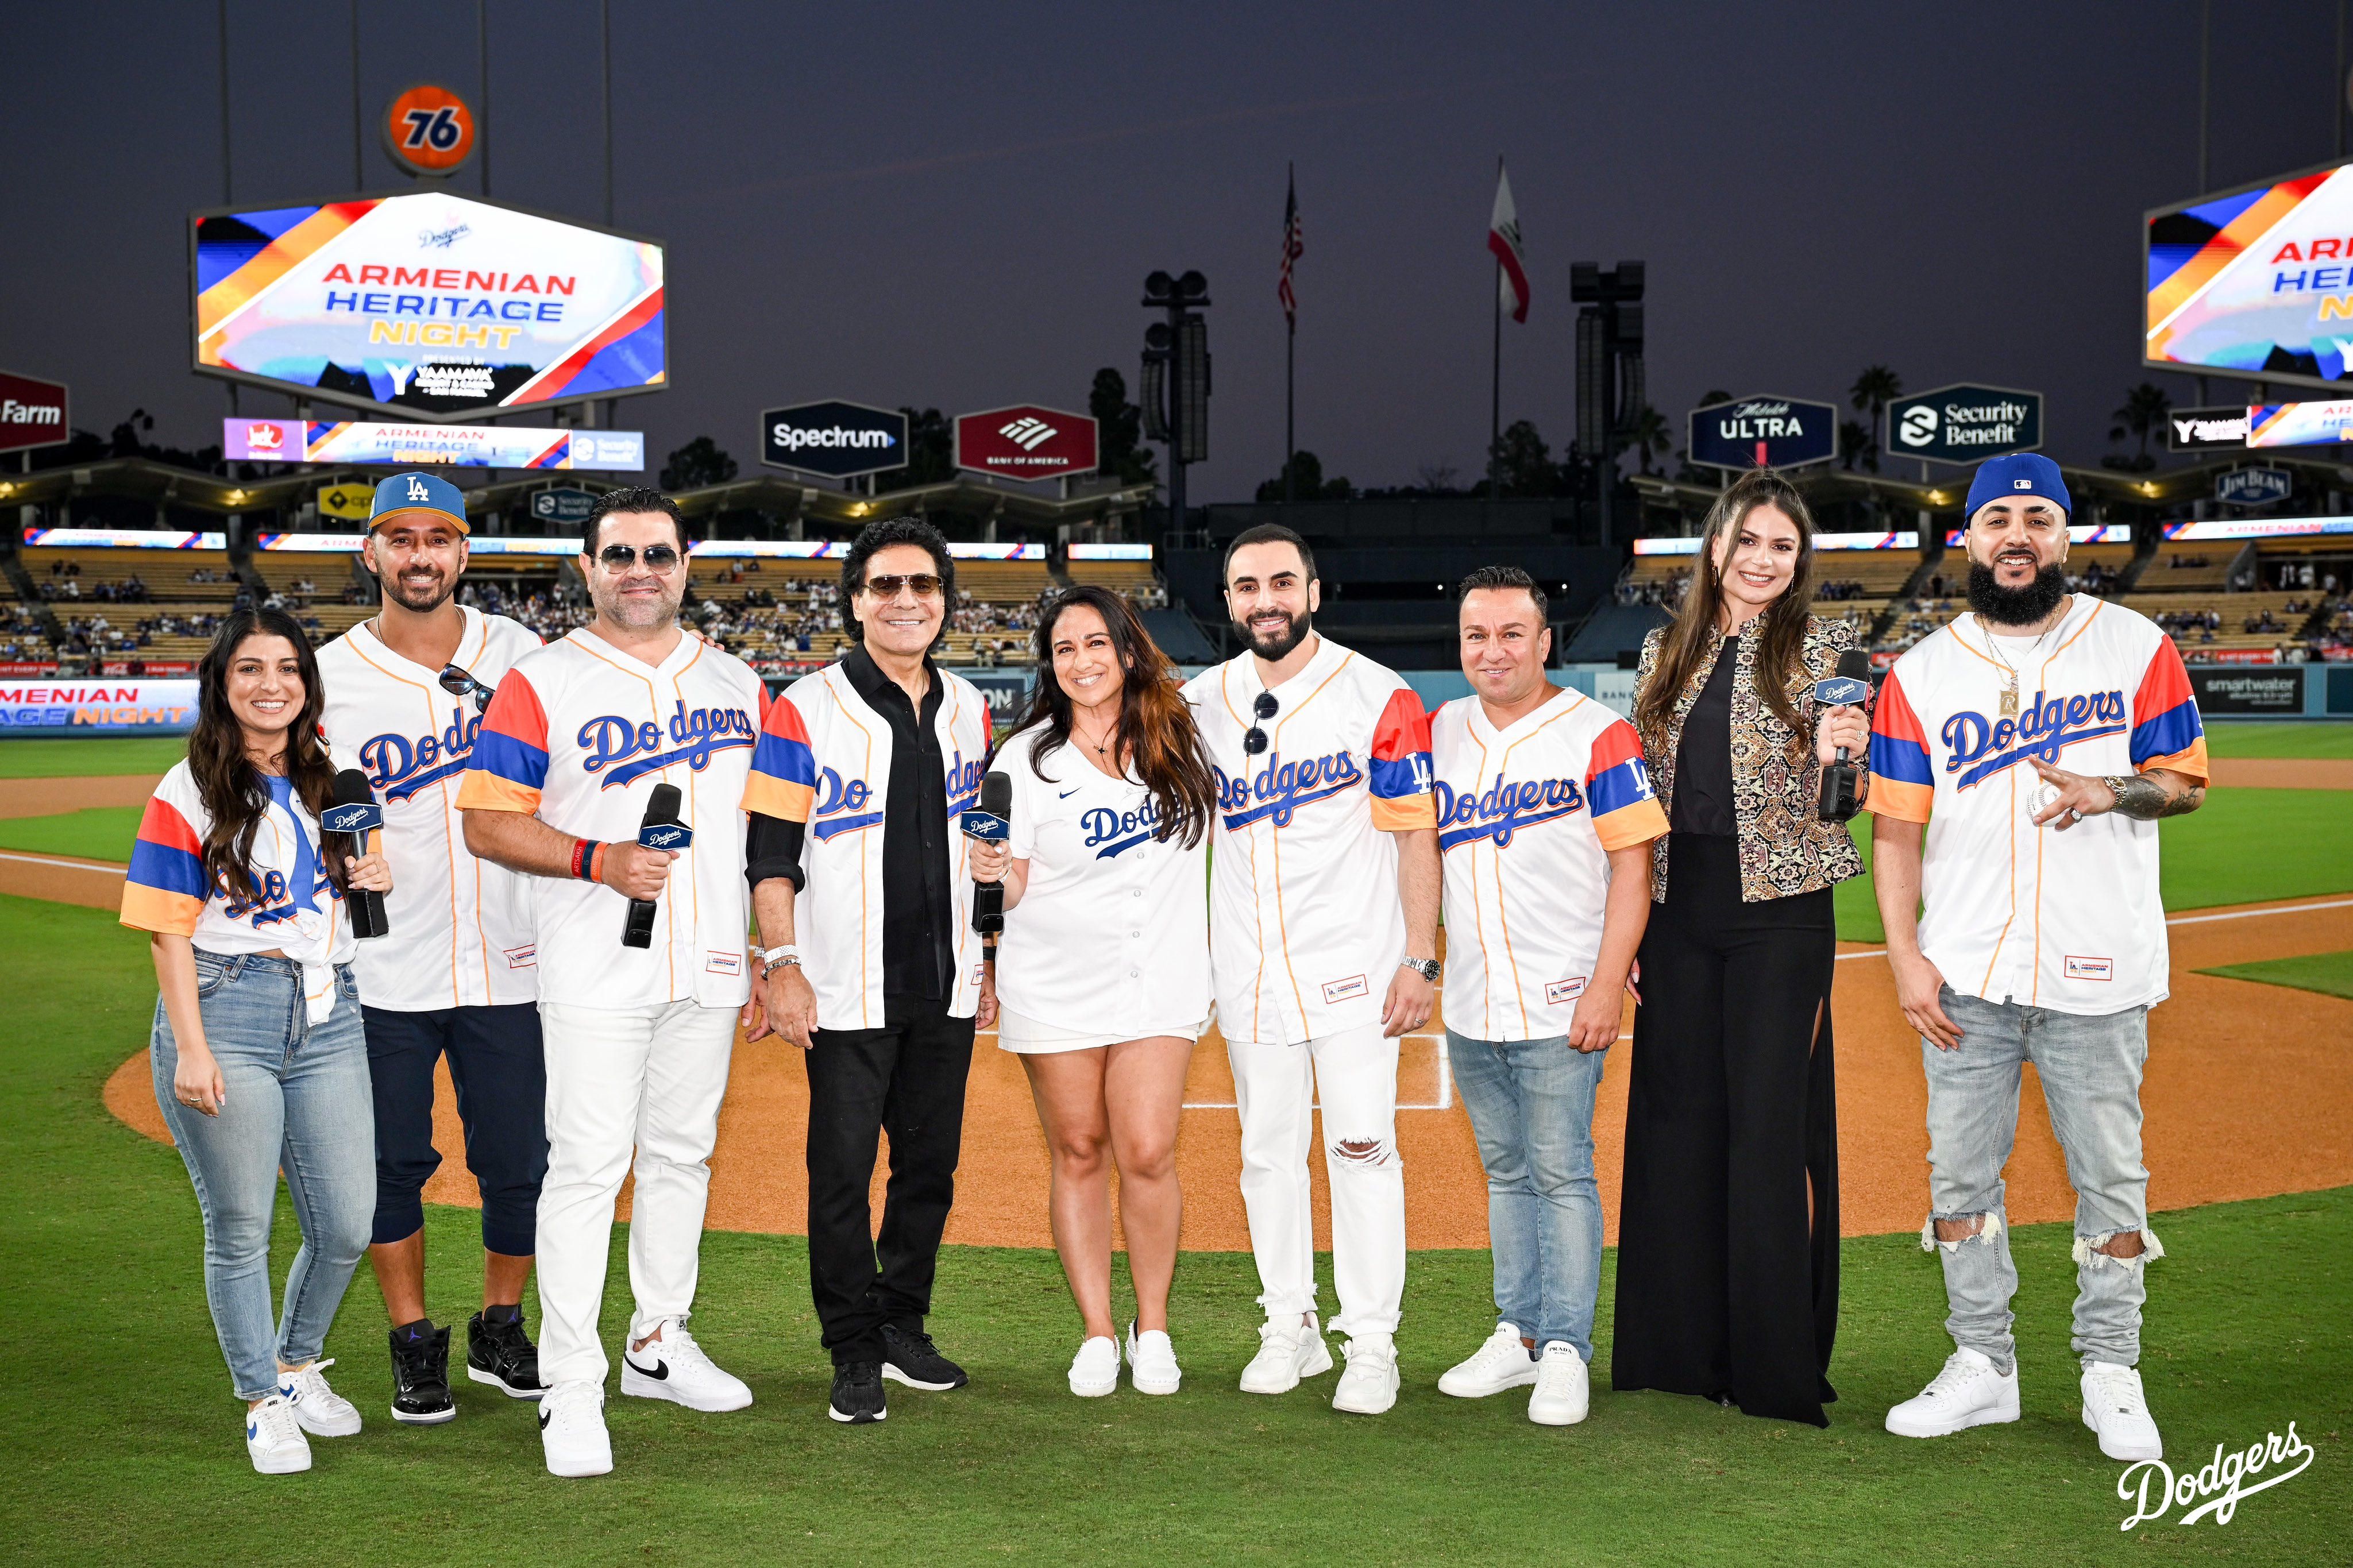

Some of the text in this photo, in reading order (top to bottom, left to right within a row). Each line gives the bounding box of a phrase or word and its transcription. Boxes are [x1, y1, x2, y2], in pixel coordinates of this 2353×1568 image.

[404, 106, 462, 151] 76
[322, 263, 576, 295] ARMENIAN
[325, 291, 564, 322] HERITAGE
[369, 320, 522, 349] NIGHT
[1, 399, 61, 425] Farm
[1945, 401, 2028, 426] Security
[375, 428, 485, 440] ARMENIAN
[773, 423, 889, 452] Spectrum
[1720, 416, 1803, 439] ULTRA
[1945, 422, 2016, 446] Benefit
[375, 440, 479, 452] HERITAGE
[392, 450, 461, 464] NIGHT
[986, 457, 1012, 465] BANK
[1027, 457, 1069, 465] AMERICA
[407, 476, 429, 501] LA
[2220, 476, 2246, 499] JIM
[2247, 469, 2286, 495] BEAM
[1825, 682, 1856, 700] Dodgers
[2205, 677, 2297, 692] smartwater
[73, 706, 188, 725] NIGHT
[577, 699, 755, 792] Dodgers
[1941, 689, 2127, 794] Dodgers
[1213, 750, 1363, 833] Dodgers
[335, 807, 368, 829] Dodgers
[971, 819, 998, 834] Dodgers
[1434, 772, 1585, 857] Dodgers
[649, 829, 682, 845] Dodgers
[574, 846, 583, 873] ARTSAKH
[592, 850, 601, 876] ARMENIA
[1337, 981, 1362, 990] ARMENIAN
[1337, 984, 1360, 992] HERITAGE
[268, 1399, 279, 1407] NIKE
